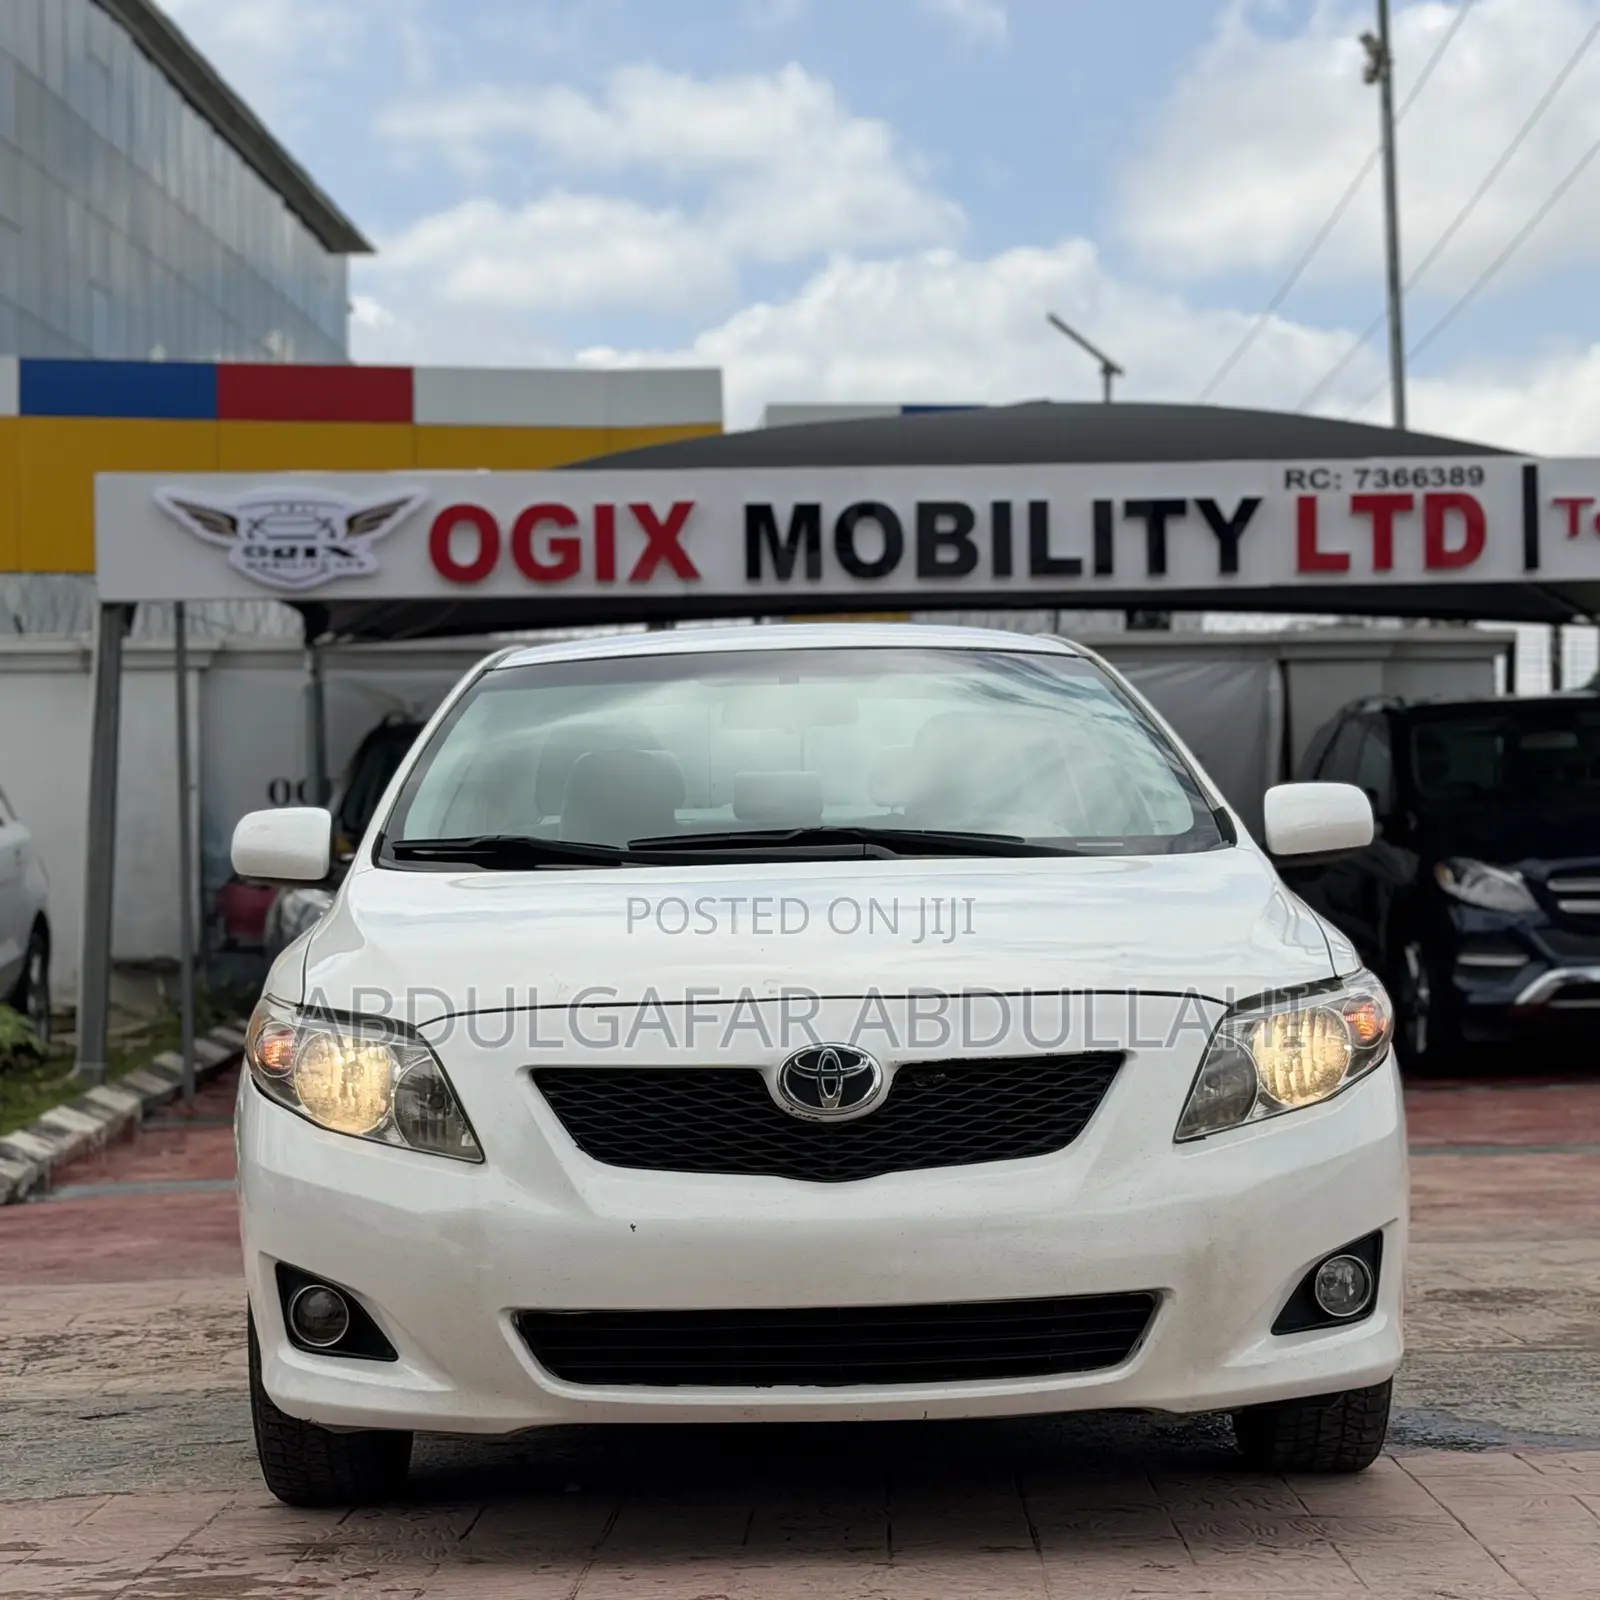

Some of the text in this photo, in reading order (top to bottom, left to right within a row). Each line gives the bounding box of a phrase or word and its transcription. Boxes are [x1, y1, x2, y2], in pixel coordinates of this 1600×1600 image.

[1284, 465, 1485, 491] RC: 7366389
[428, 492, 1488, 584] OGIX MOBILITY LTD
[1552, 497, 1600, 538] T
